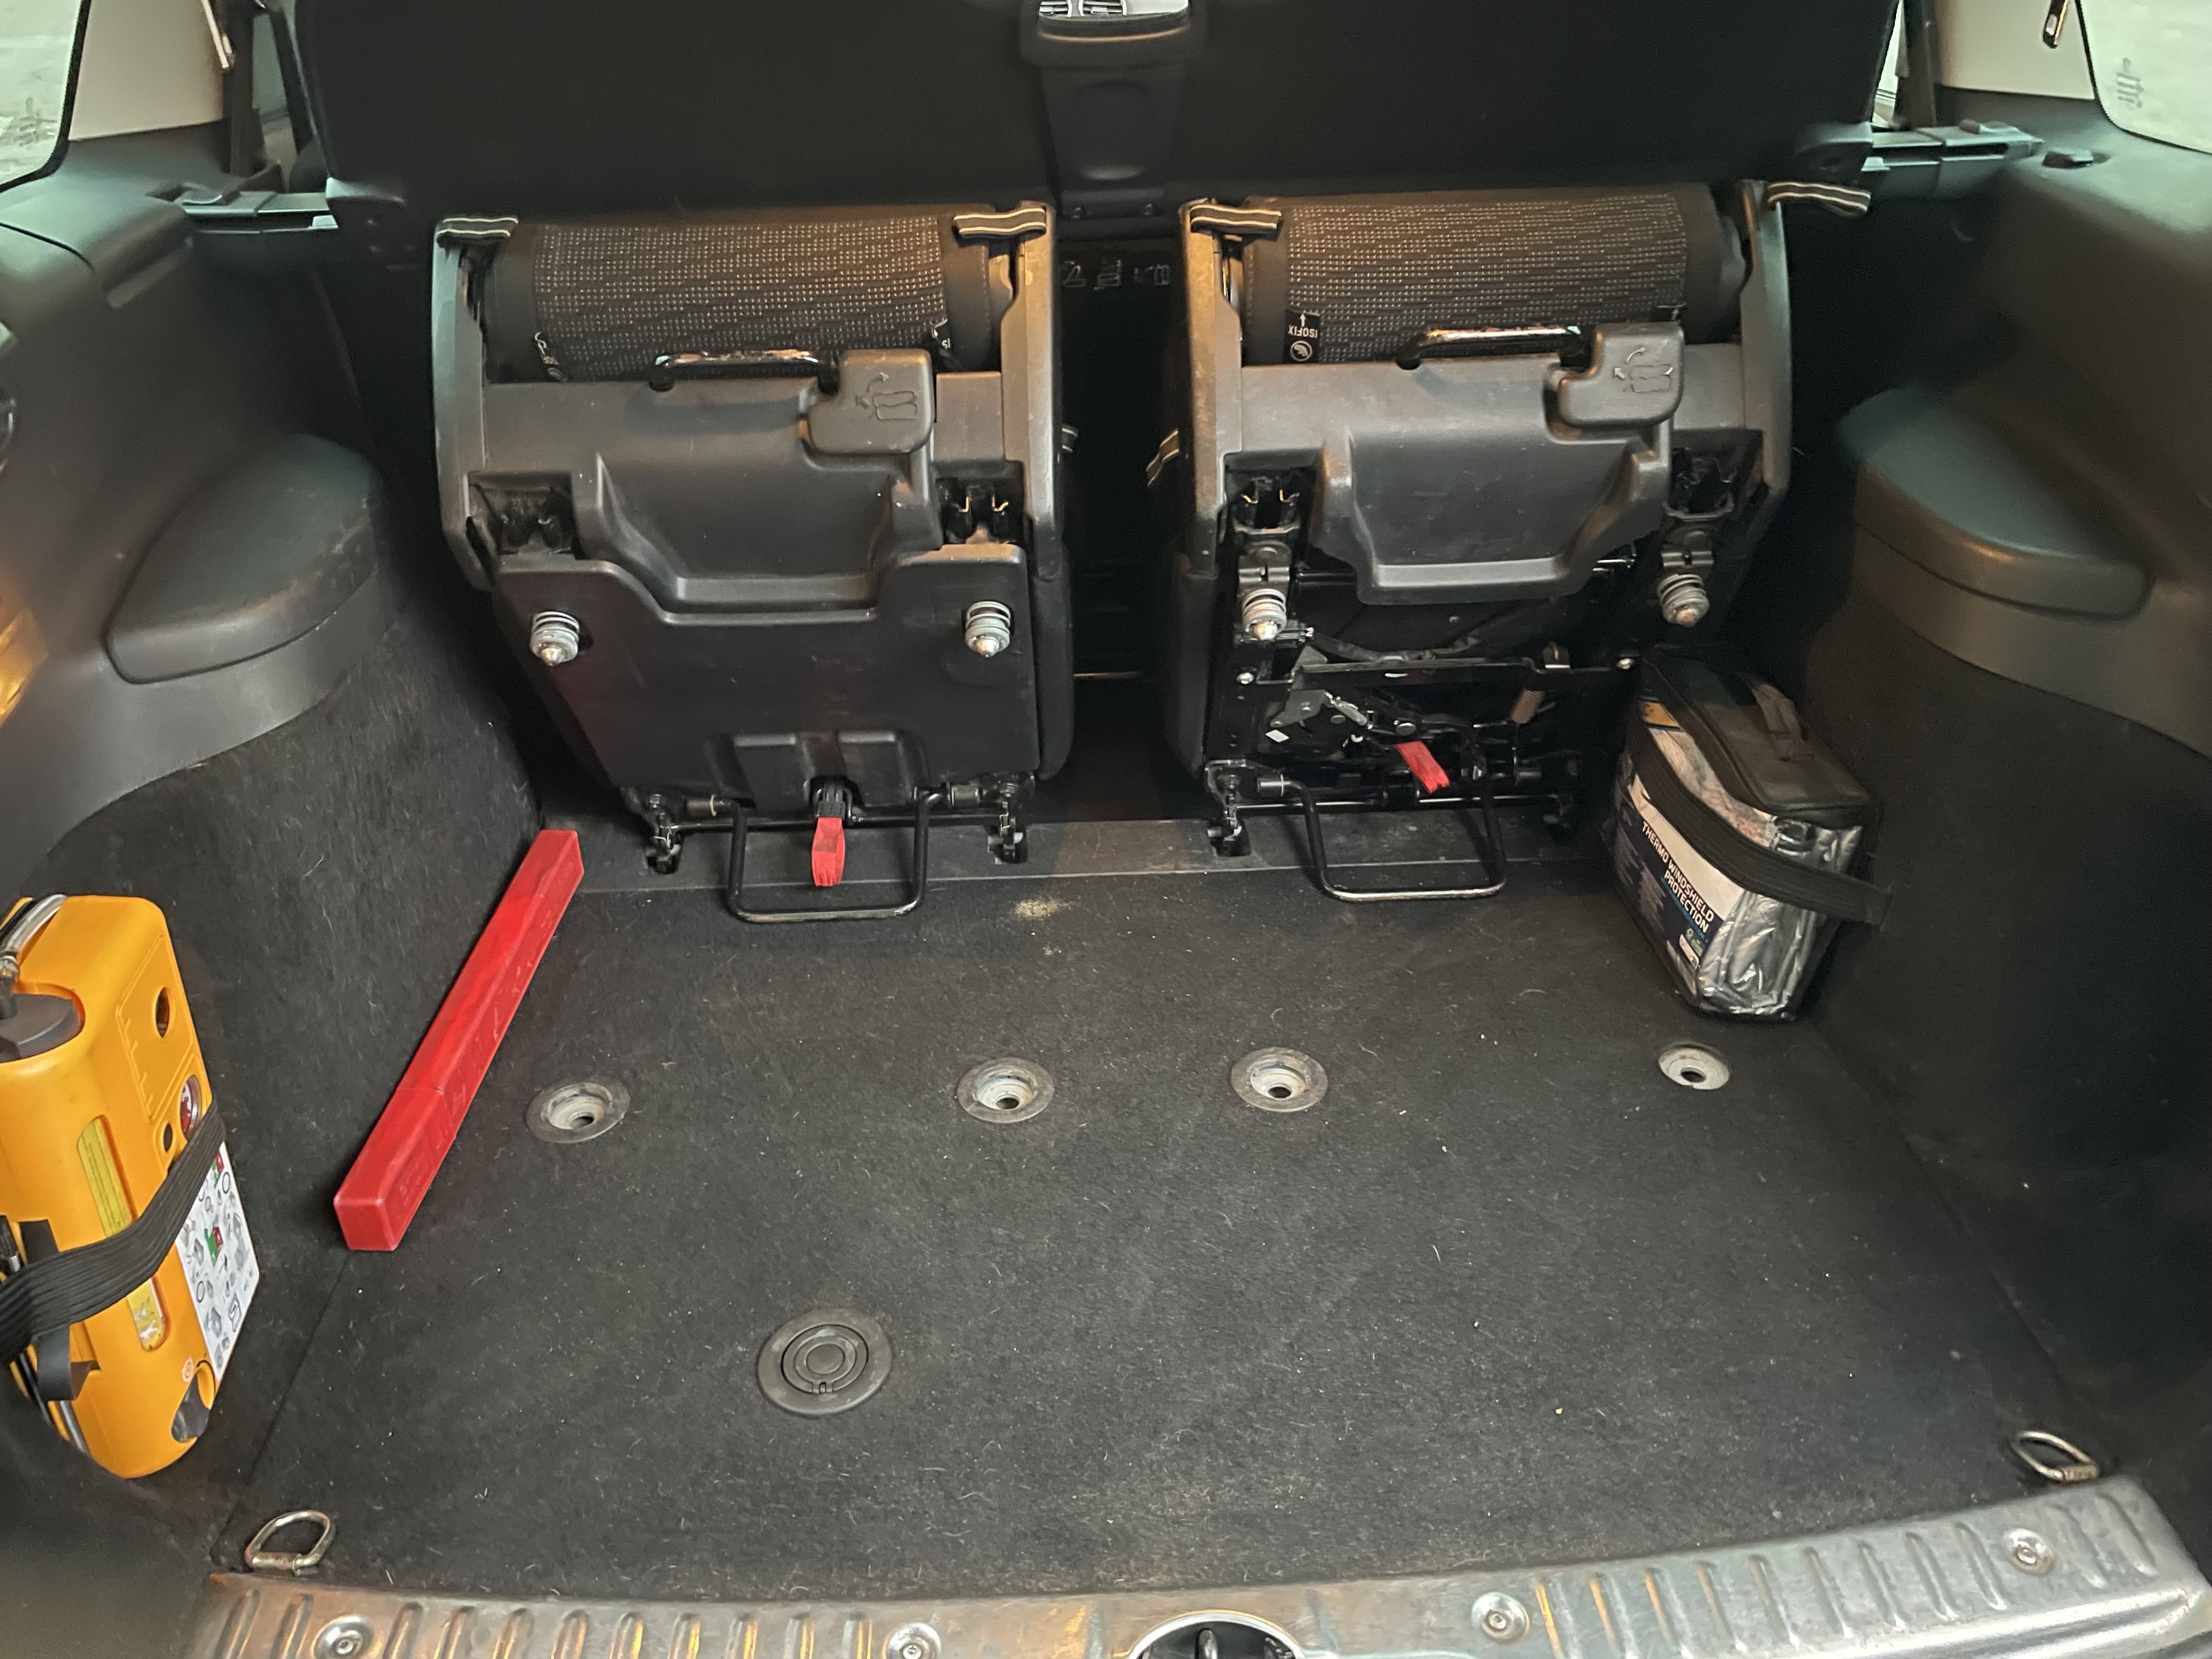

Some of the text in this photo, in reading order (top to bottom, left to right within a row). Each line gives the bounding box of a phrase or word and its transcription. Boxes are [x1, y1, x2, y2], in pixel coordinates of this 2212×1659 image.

[1288, 324, 1318, 339] ISOFIX
[1641, 821, 1669, 864] THERMO
[1667, 857, 1714, 923] WINDSHIELD
[1663, 870, 1710, 933] PROTECTION
